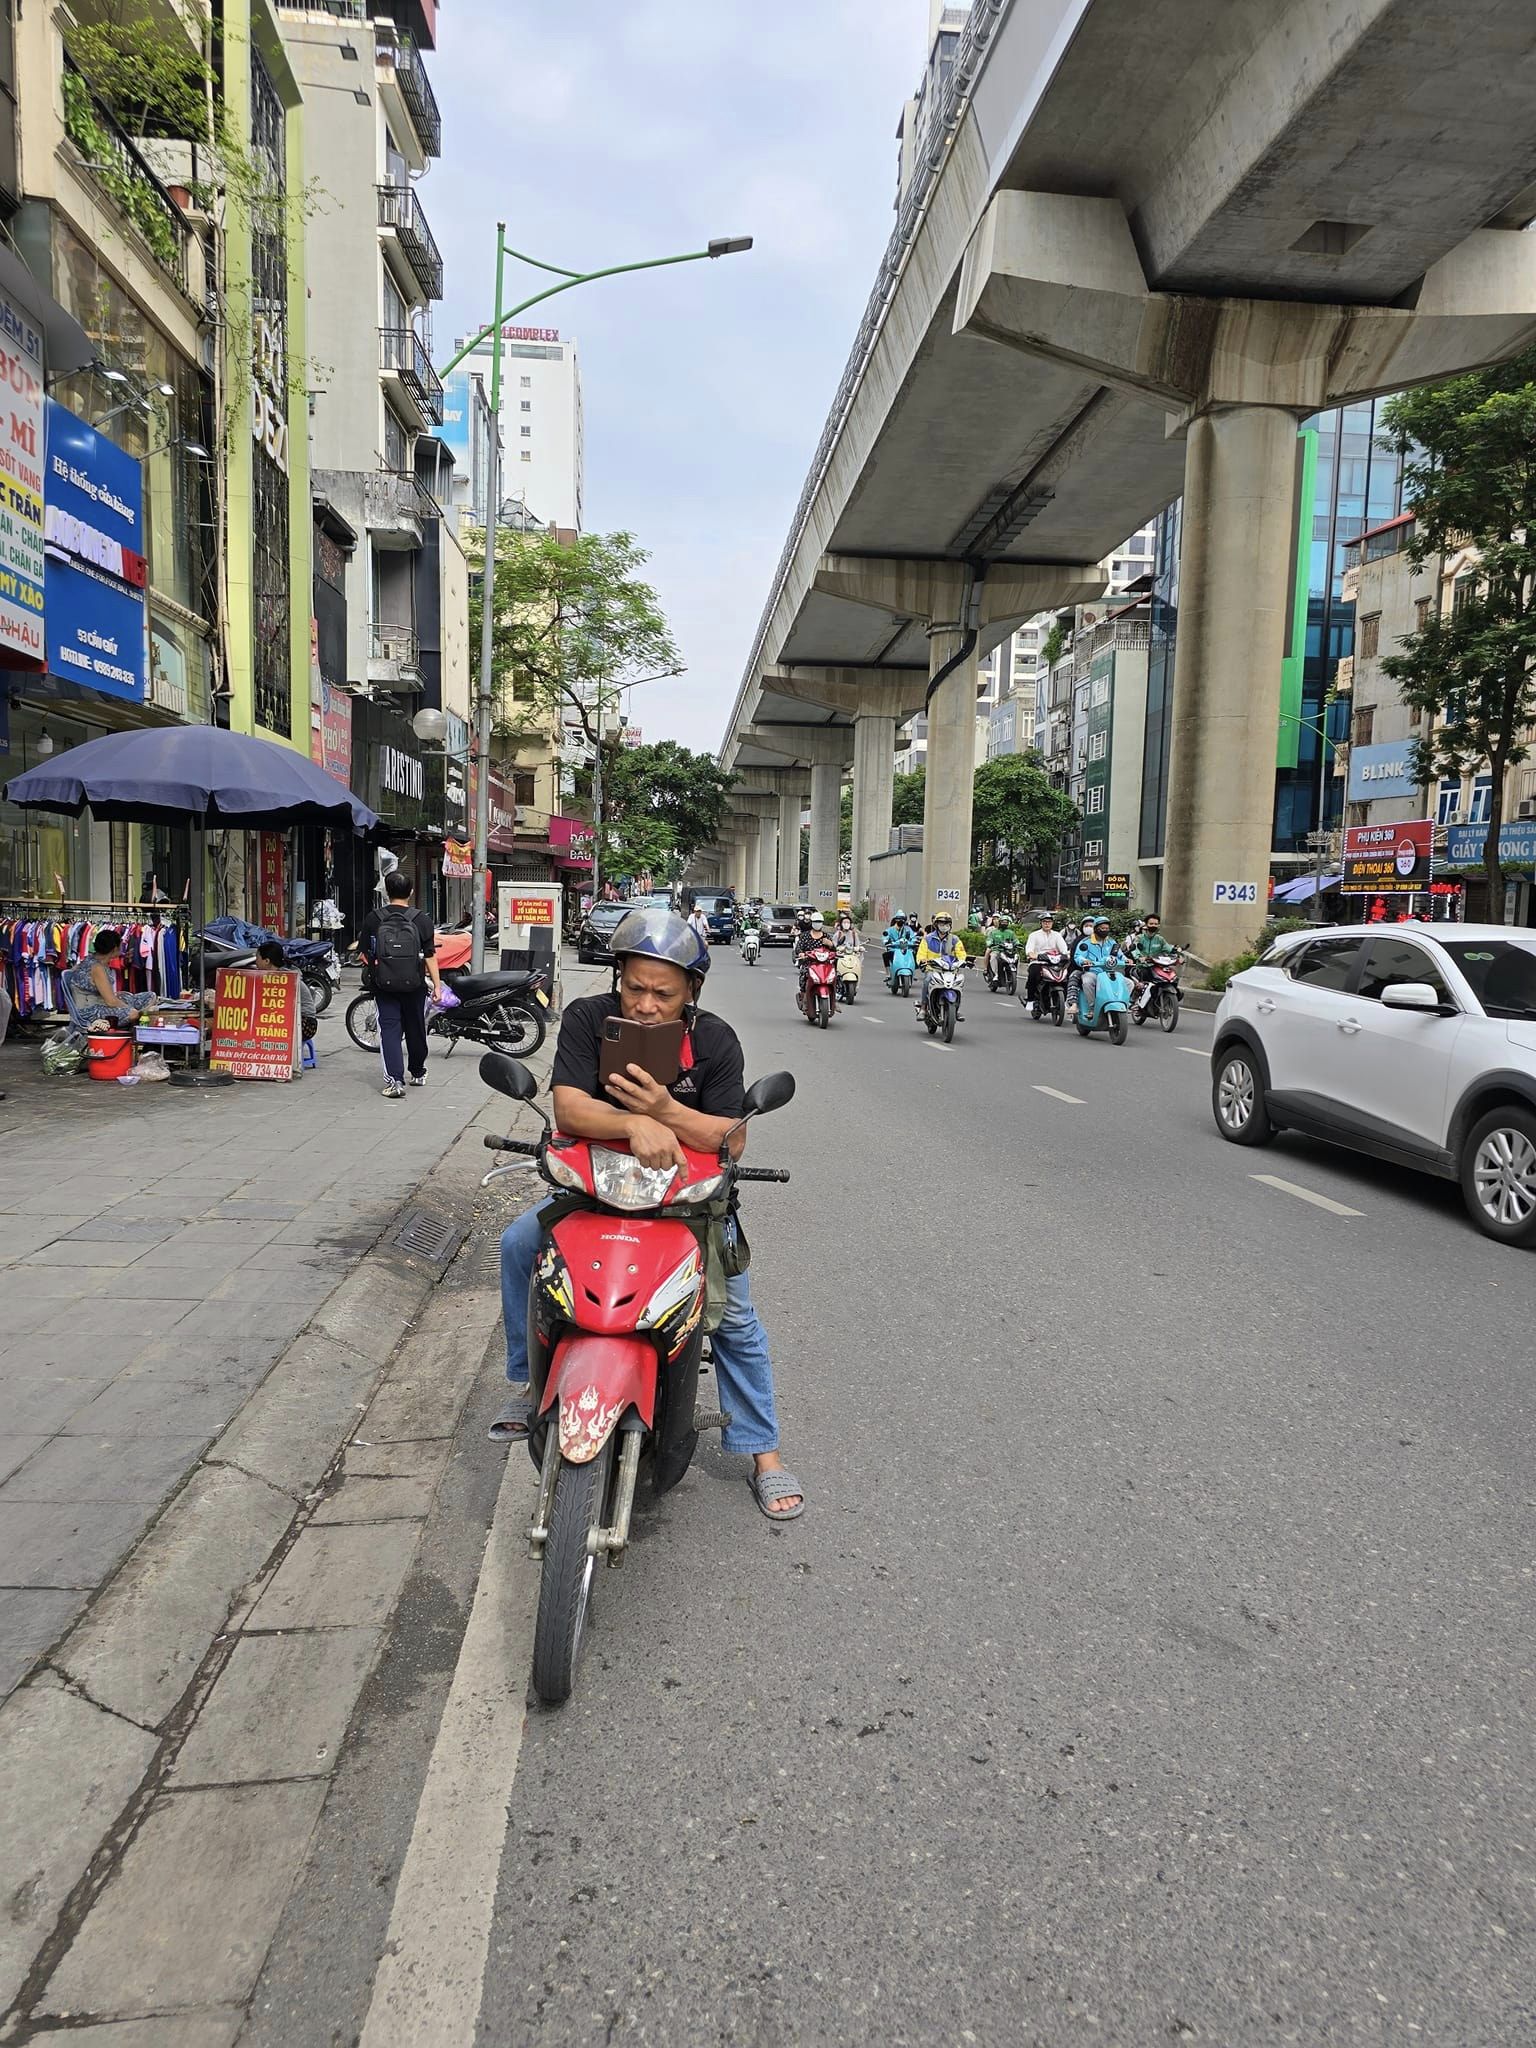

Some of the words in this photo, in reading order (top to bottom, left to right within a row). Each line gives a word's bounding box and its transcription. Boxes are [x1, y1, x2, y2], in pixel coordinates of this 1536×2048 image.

[26, 329, 40, 360] 51
[10, 411, 36, 457] MÌ
[18, 462, 41, 494] VANG
[53, 455, 69, 482] Hệ
[19, 582, 44, 611] XÀO
[0, 615, 40, 648] NHẬU
[265, 708, 274, 731] 59
[385, 745, 423, 801] ARISTINO
[1362, 761, 1404, 781] BLINK
[1357, 831, 1370, 845] PHỤ
[1369, 827, 1384, 845] KIỆN
[1452, 839, 1477, 858] GIẤY
[937, 890, 960, 900] P342
[1216, 884, 1256, 901] P343
[223, 971, 247, 1000] XÔI
[262, 986, 287, 998] XÉO
[262, 998, 285, 1010] LẠC
[216, 1006, 249, 1036] NGỌC
[600, 1234, 641, 1243] HONDA
